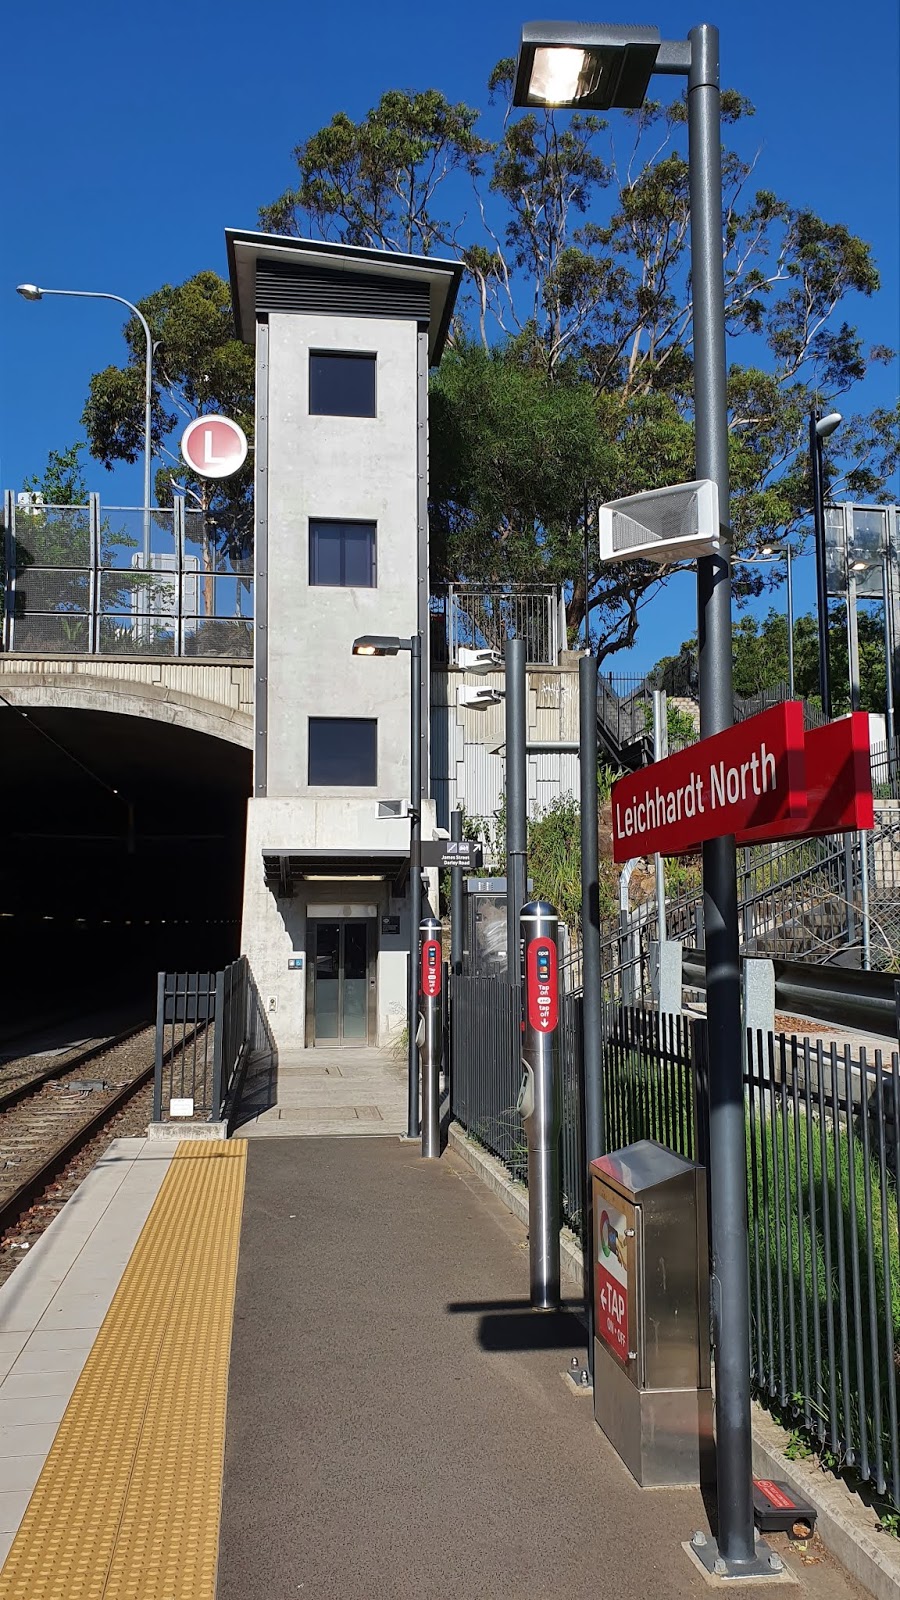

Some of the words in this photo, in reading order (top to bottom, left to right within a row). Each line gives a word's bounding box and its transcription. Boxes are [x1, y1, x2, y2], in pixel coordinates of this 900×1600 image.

[204, 430, 227, 463] L
[616, 772, 704, 839] Leichhardt
[710, 743, 777, 809] North
[606, 1282, 625, 1325] TAP
